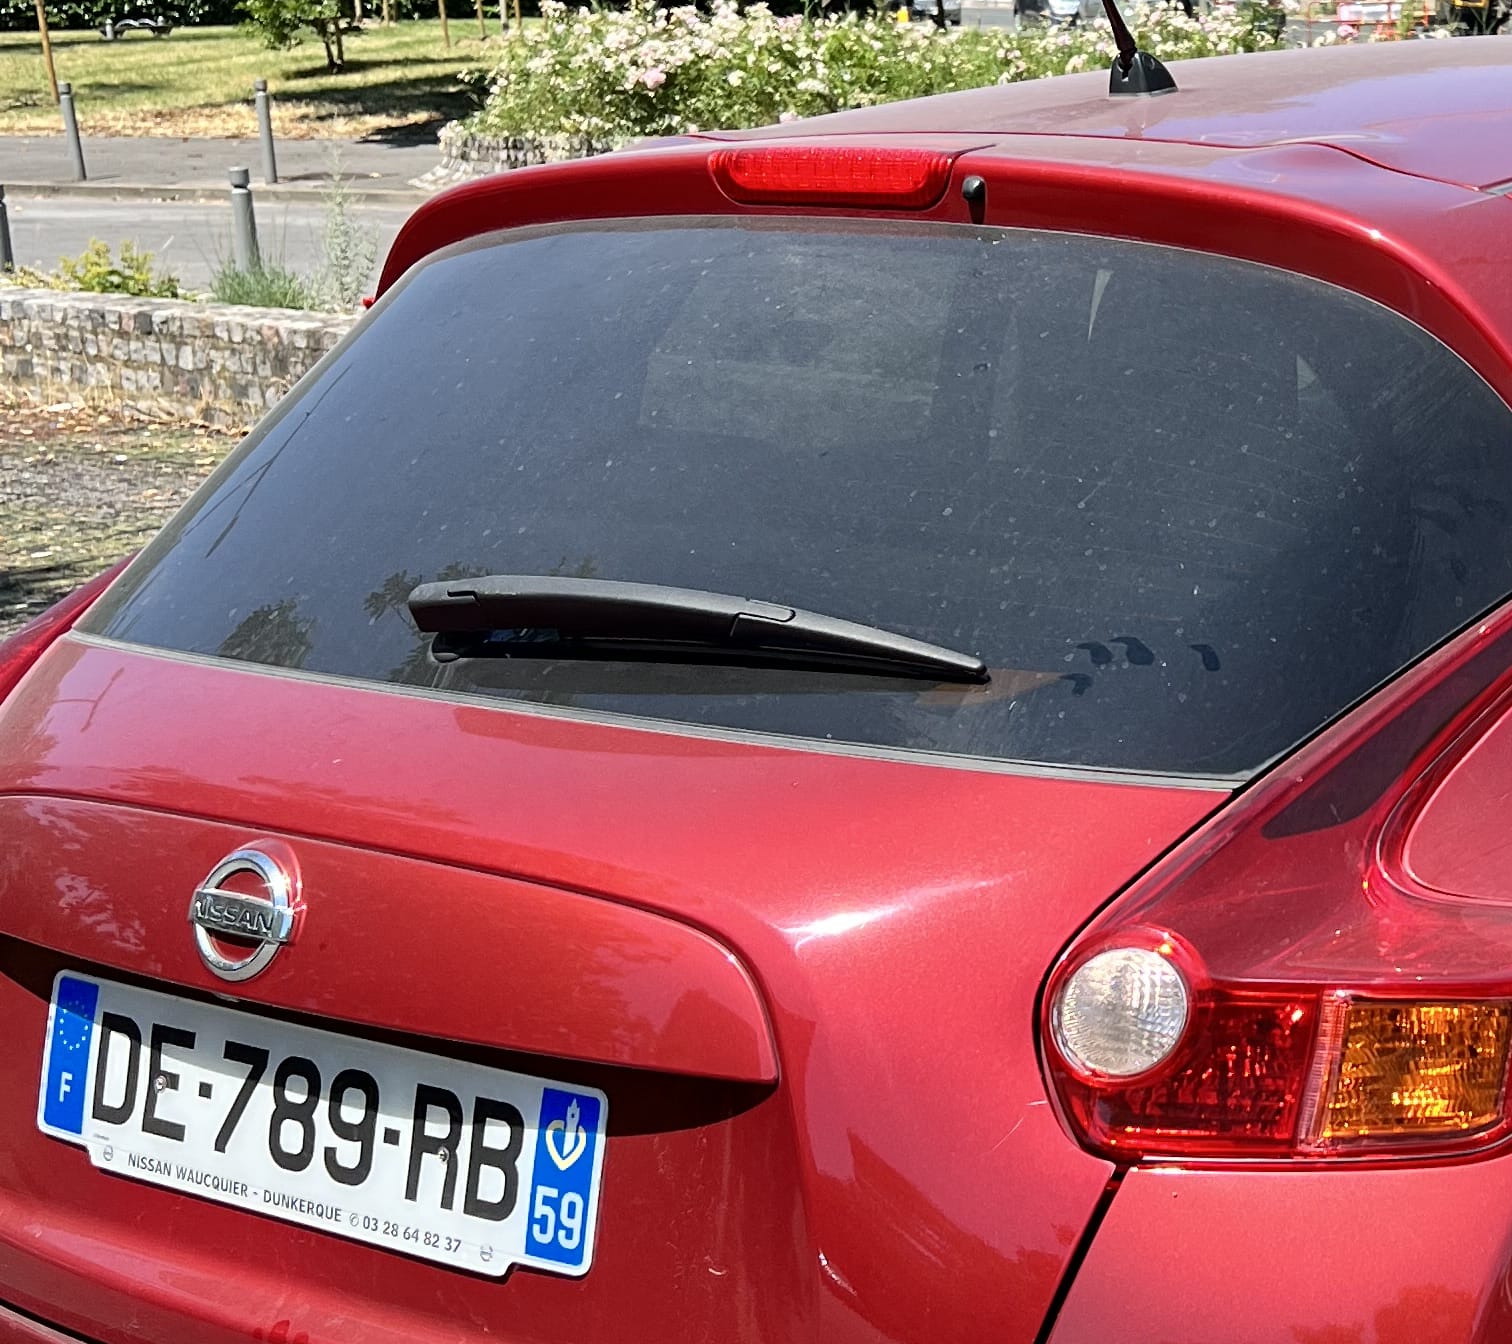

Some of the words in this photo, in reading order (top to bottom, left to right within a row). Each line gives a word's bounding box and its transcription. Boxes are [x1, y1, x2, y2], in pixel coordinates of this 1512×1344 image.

[194, 896, 274, 938] NISSAN
[59, 1071, 73, 1103] F
[92, 1011, 526, 1223] DE-789-RB
[127, 1153, 172, 1177] NISSAN
[175, 1165, 249, 1197] WAUCQUIER
[263, 1189, 342, 1222] DUNKERQUE
[363, 1215, 379, 1232] 03
[383, 1221, 399, 1238] 28
[403, 1226, 420, 1243] 64
[423, 1231, 440, 1248] 82
[444, 1236, 462, 1253] 37
[532, 1184, 584, 1250] 59
